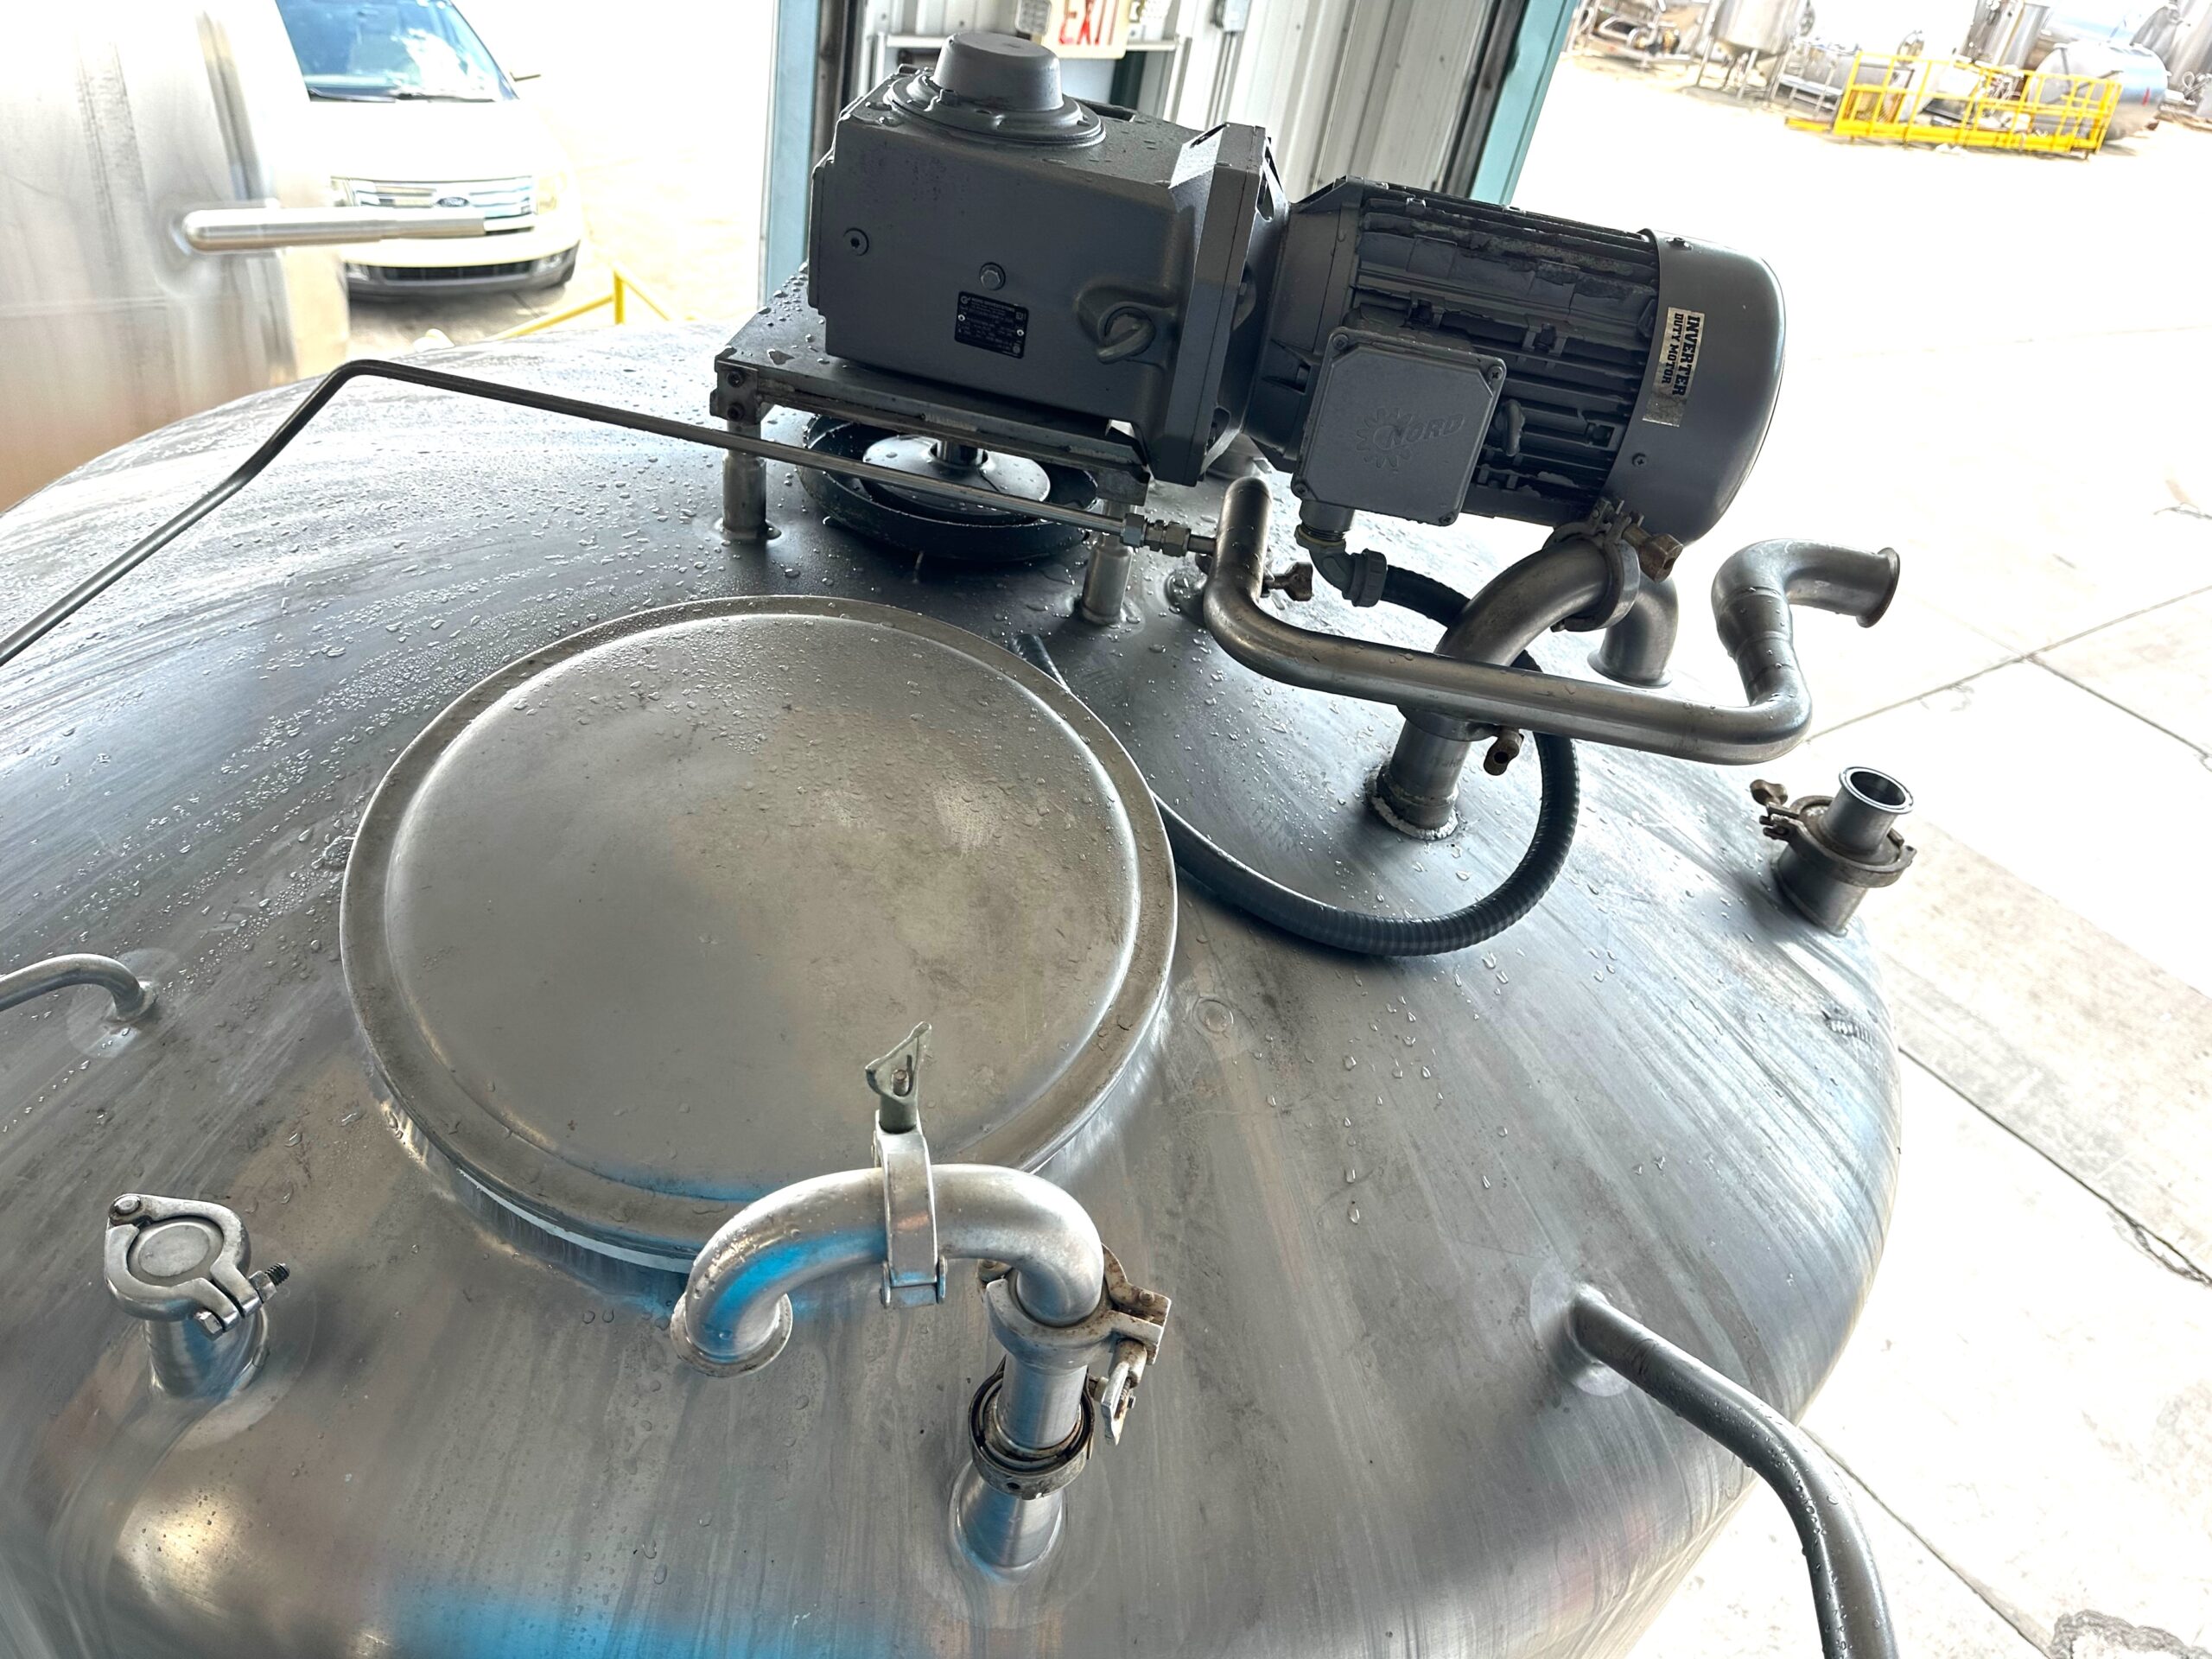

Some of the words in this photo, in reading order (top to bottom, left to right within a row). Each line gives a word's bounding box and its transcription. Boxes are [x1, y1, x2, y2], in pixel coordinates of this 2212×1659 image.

[1671, 313, 1684, 342] DUTY
[1662, 344, 1679, 384] MOTOR
[1672, 315, 1700, 396] INVERTER
[1385, 413, 1465, 447] NORD
